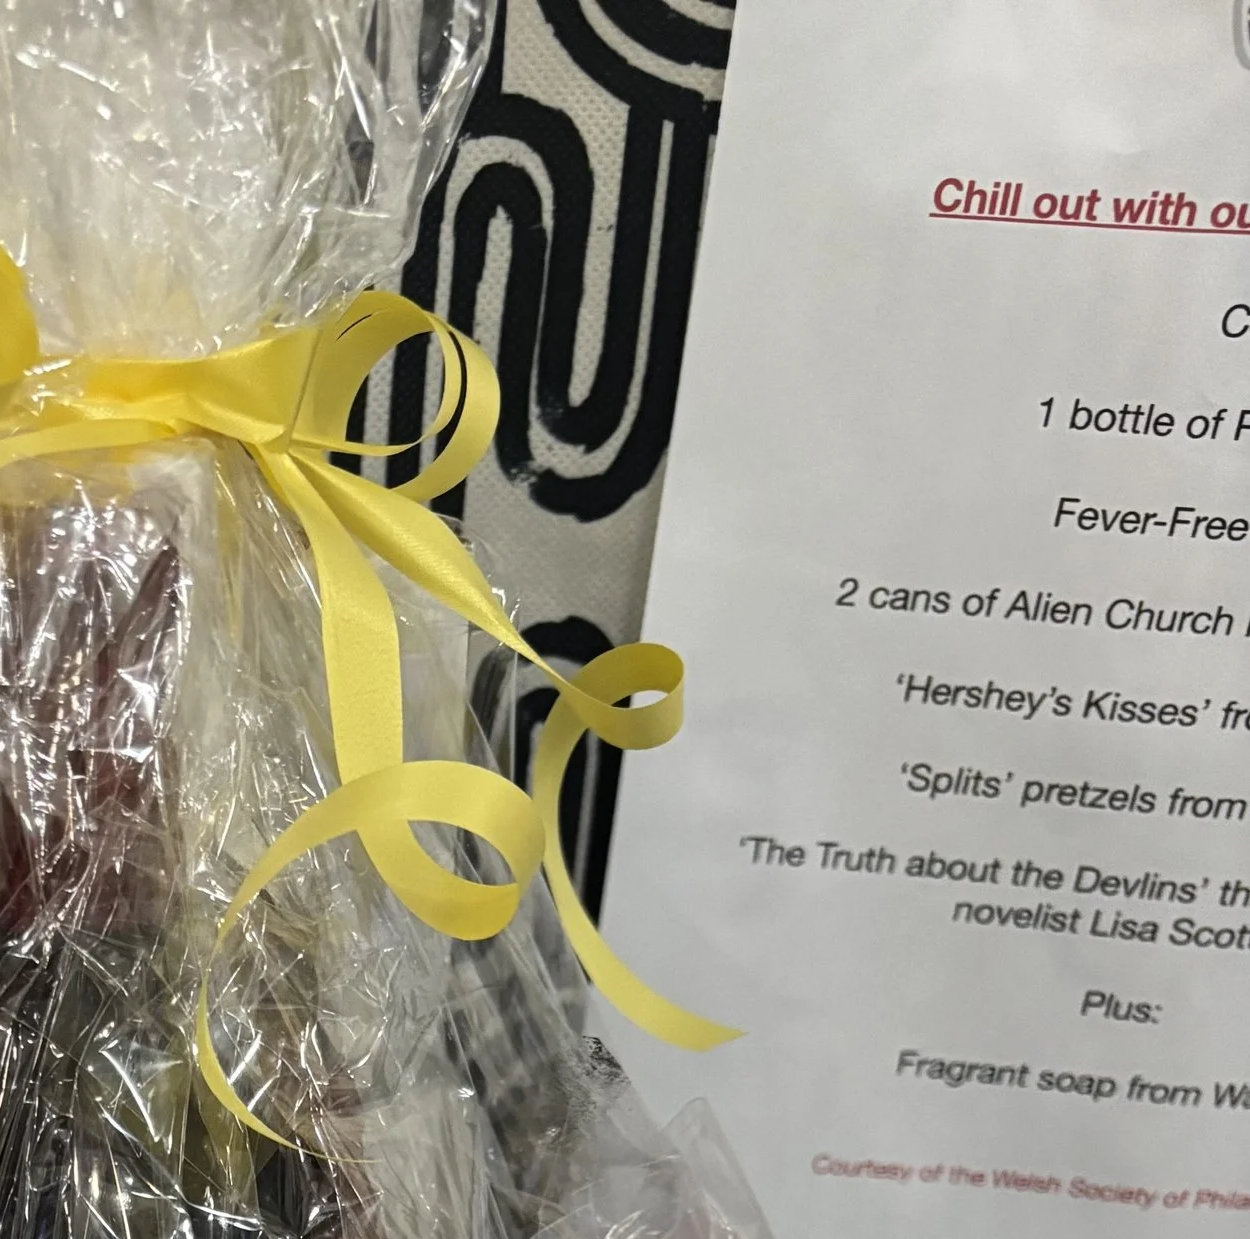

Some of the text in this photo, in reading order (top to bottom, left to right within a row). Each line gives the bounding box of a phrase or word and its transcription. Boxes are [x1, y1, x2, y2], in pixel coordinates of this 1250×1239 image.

[933, 177, 1023, 214] Chill
[1033, 189, 1102, 221] out
[1112, 191, 1198, 227] with
[1039, 397, 1054, 427] 1
[1069, 398, 1175, 437] bottle
[1186, 408, 1228, 440] of
[1053, 497, 1249, 542] Fever-Free
[836, 577, 859, 607] 2
[868, 586, 951, 614] cans
[962, 588, 1001, 617] of
[1004, 590, 1092, 626] Alien
[1105, 598, 1234, 636] Church
[1020, 779, 1157, 814] pretzels
[1167, 787, 1247, 821] from
[817, 840, 895, 875] Truth
[905, 850, 1001, 885] about
[1011, 861, 1064, 890] the
[952, 901, 1080, 935] novelist
[1089, 910, 1159, 943] Lisa
[1080, 989, 1163, 1025] Plus:
[895, 1049, 1030, 1088] Fragrant
[1037, 1069, 1117, 1101] soap
[1127, 1074, 1201, 1107] from
[811, 1151, 911, 1185] Courtesy
[918, 1162, 946, 1183] of
[949, 1166, 987, 1187] the
[992, 1169, 1063, 1194] Welsh
[1067, 1175, 1156, 1209] Society
[1162, 1189, 1191, 1209] of
